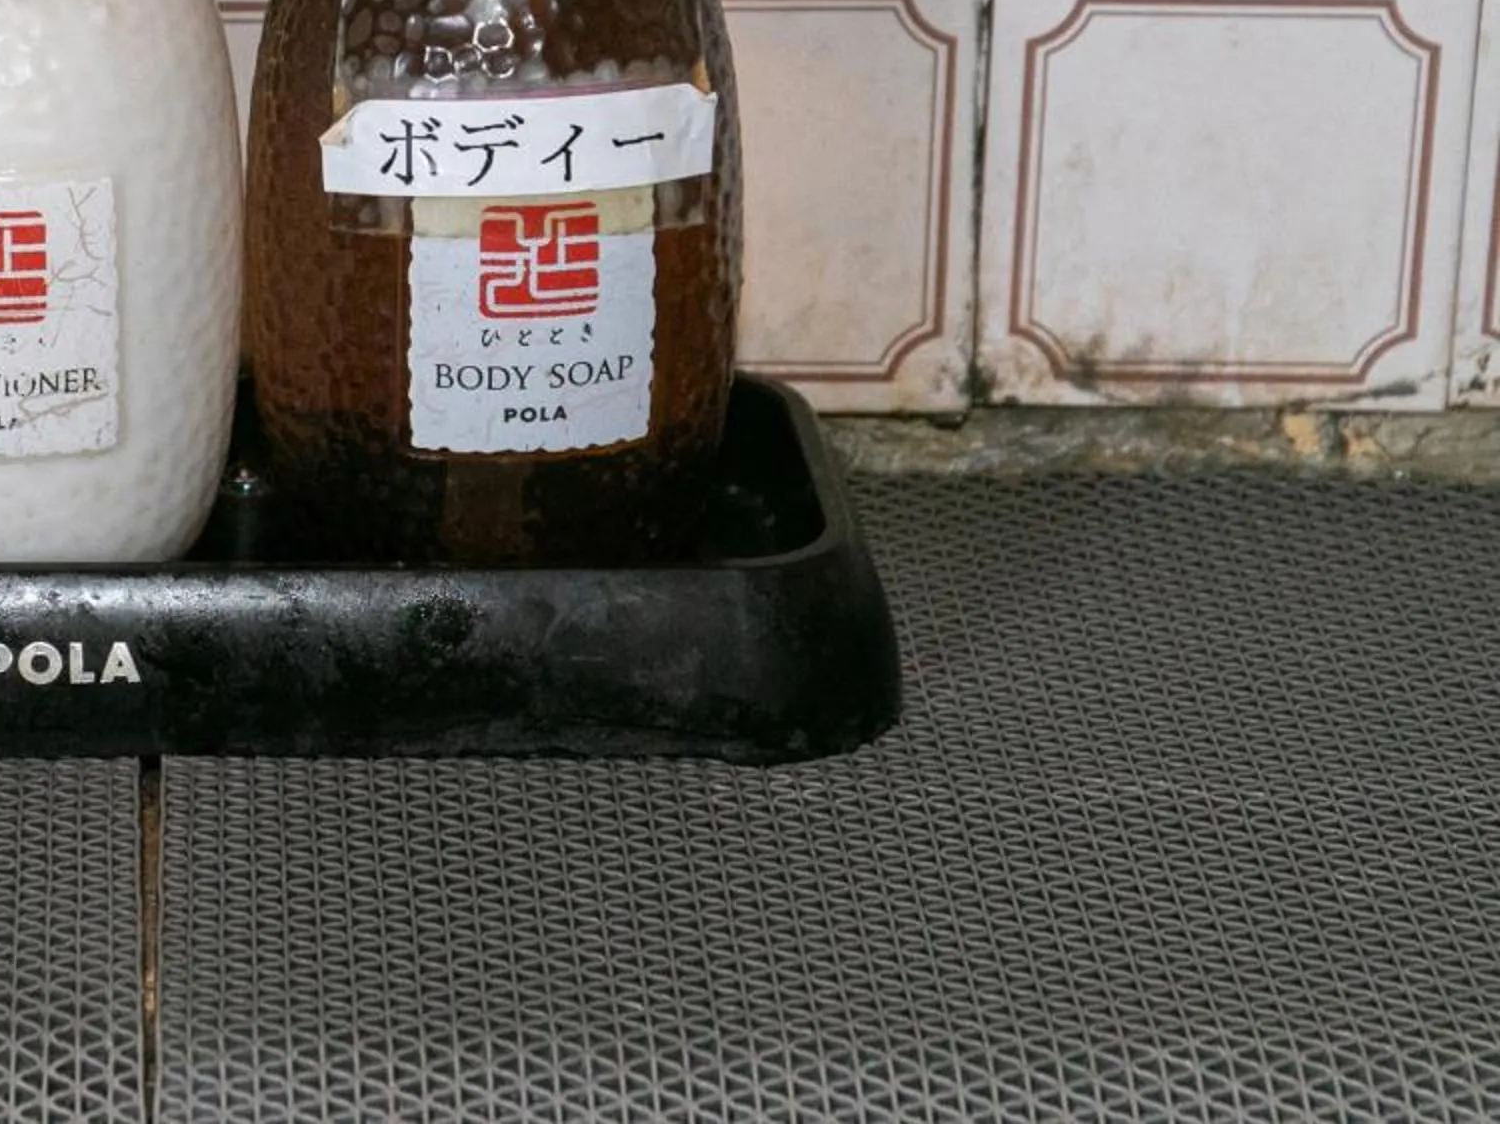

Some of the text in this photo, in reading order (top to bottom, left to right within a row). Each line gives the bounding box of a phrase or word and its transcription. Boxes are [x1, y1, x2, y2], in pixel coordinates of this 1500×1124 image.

[379, 114, 665, 186] ボディー
[435, 355, 635, 390] BODY SOAP
[503, 405, 568, 423] POLA
